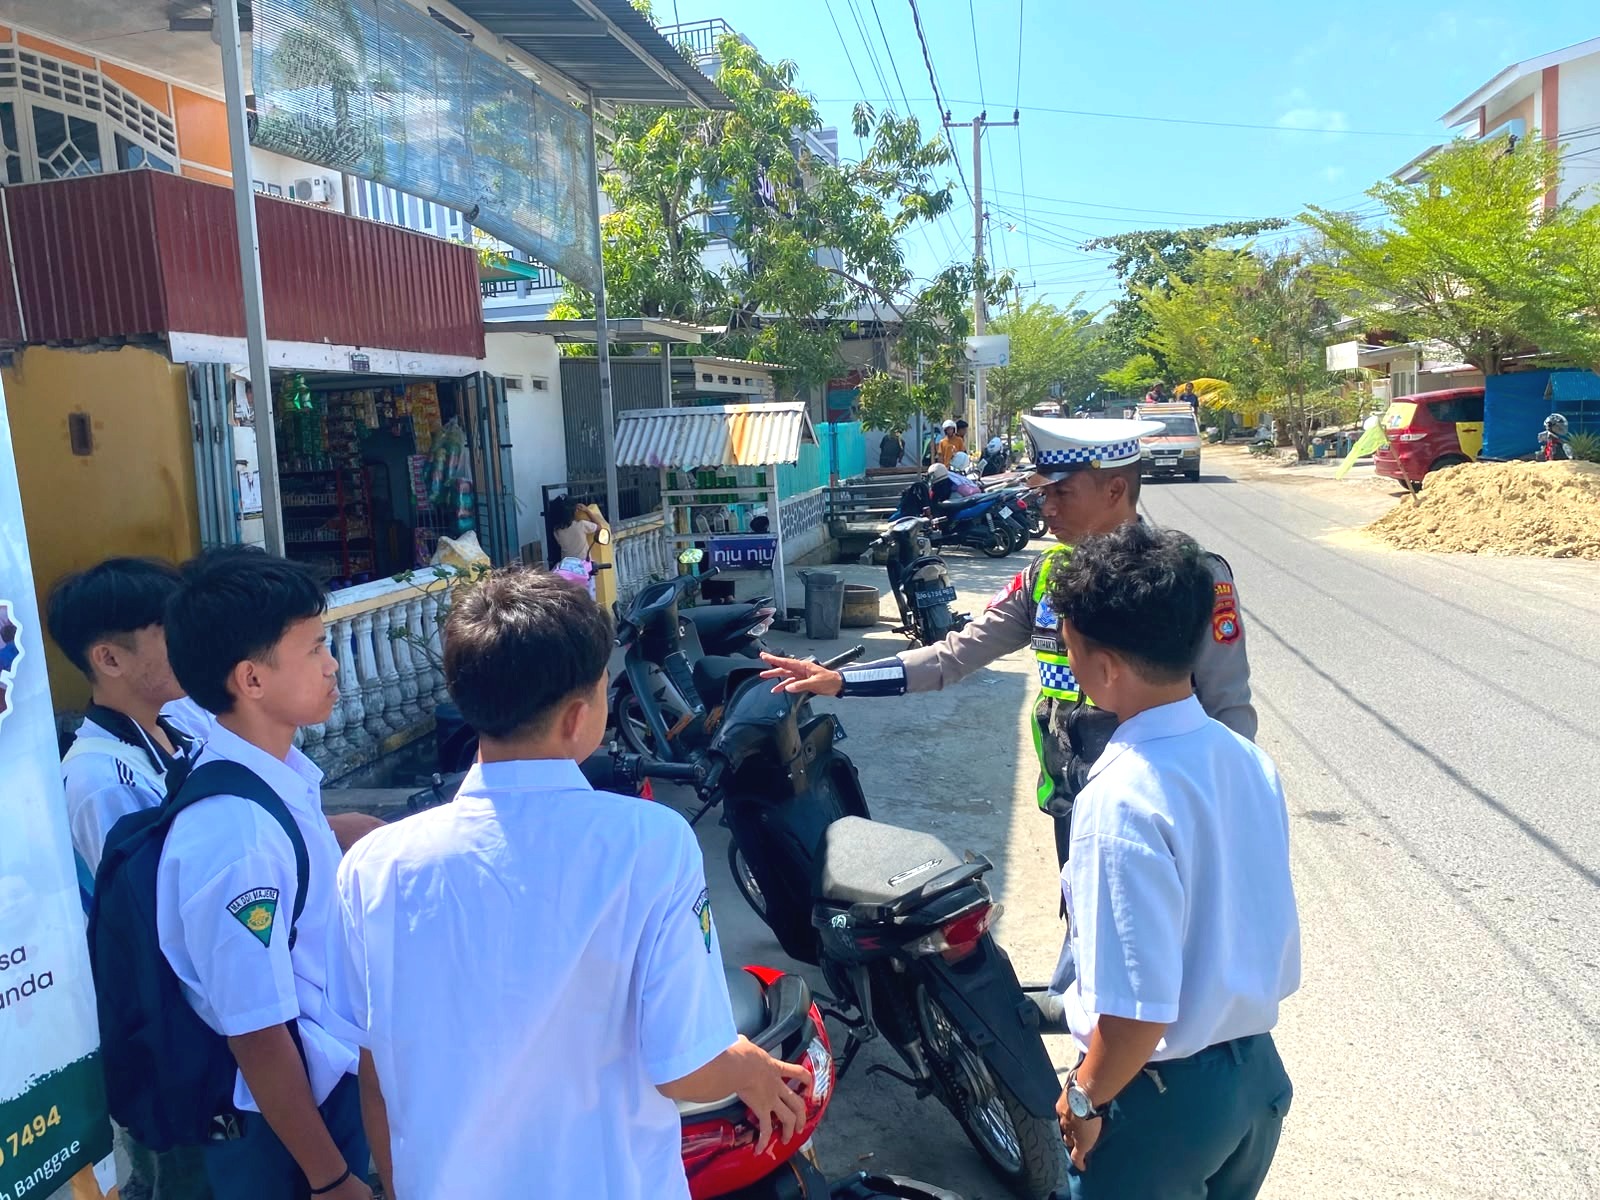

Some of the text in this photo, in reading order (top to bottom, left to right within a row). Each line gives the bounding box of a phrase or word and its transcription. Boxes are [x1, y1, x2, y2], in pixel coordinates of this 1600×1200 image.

[231, 901, 241, 911] MA
[253, 890, 275, 899] MAJENE
[6, 1104, 61, 1157] 7494
[14, 1139, 81, 1198] Banggae
